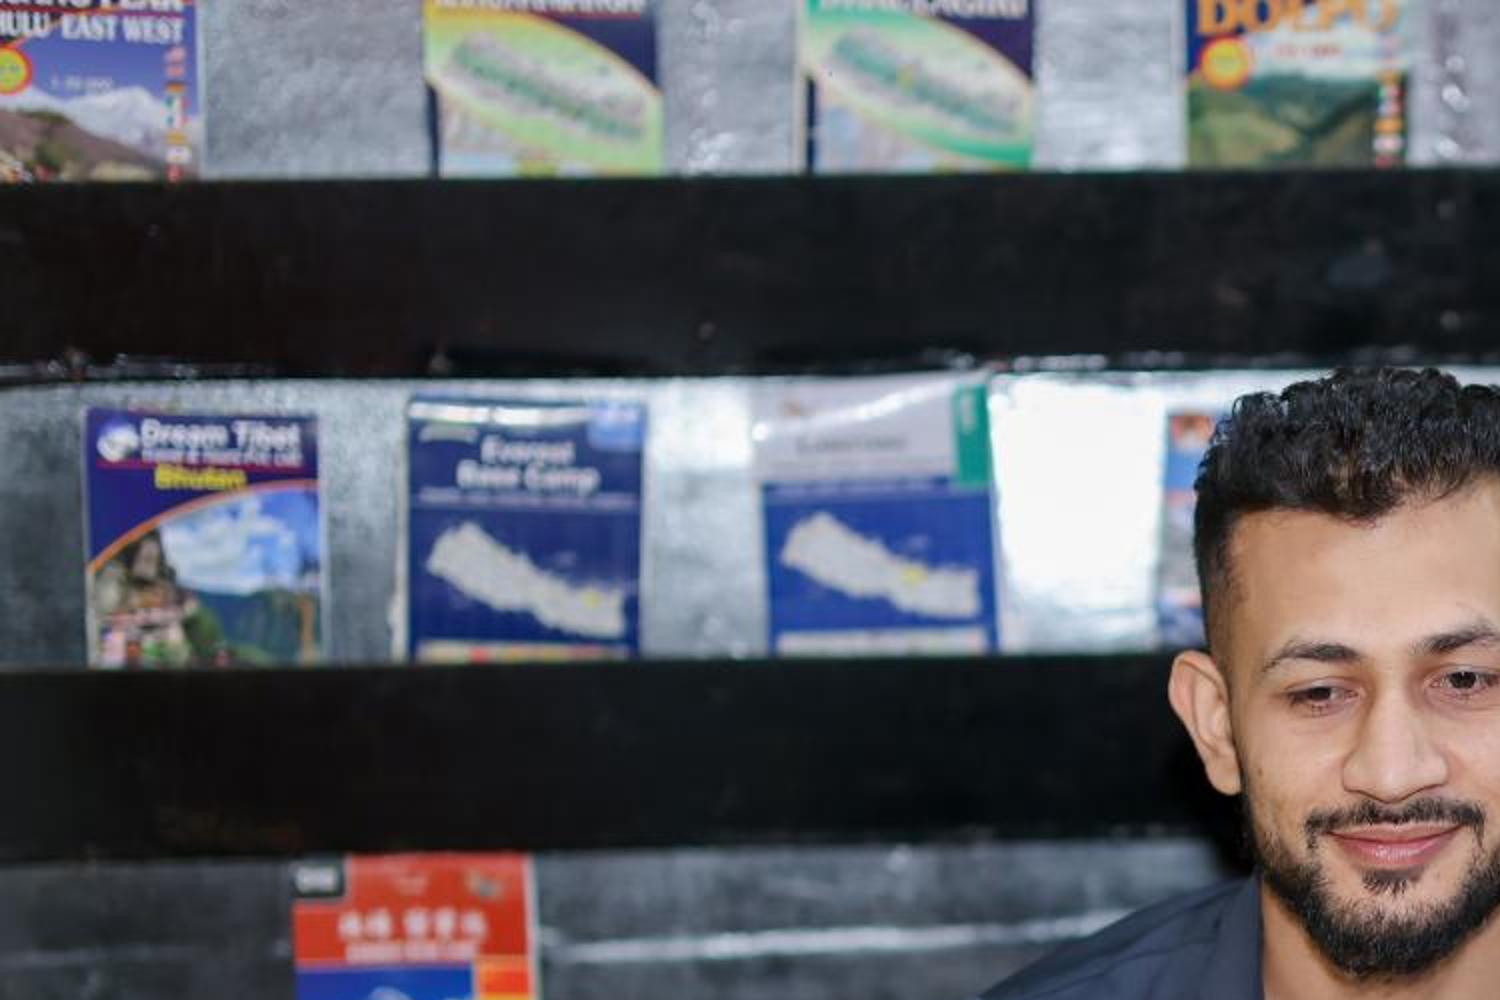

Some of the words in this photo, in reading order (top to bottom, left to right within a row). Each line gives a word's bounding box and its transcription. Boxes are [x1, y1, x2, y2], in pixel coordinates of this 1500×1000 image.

[61, 14, 115, 41] EAST
[121, 16, 183, 44] WEST
[141, 418, 229, 448] Dream
[231, 420, 302, 450] Tibet
[523, 462, 601, 497] Camp
